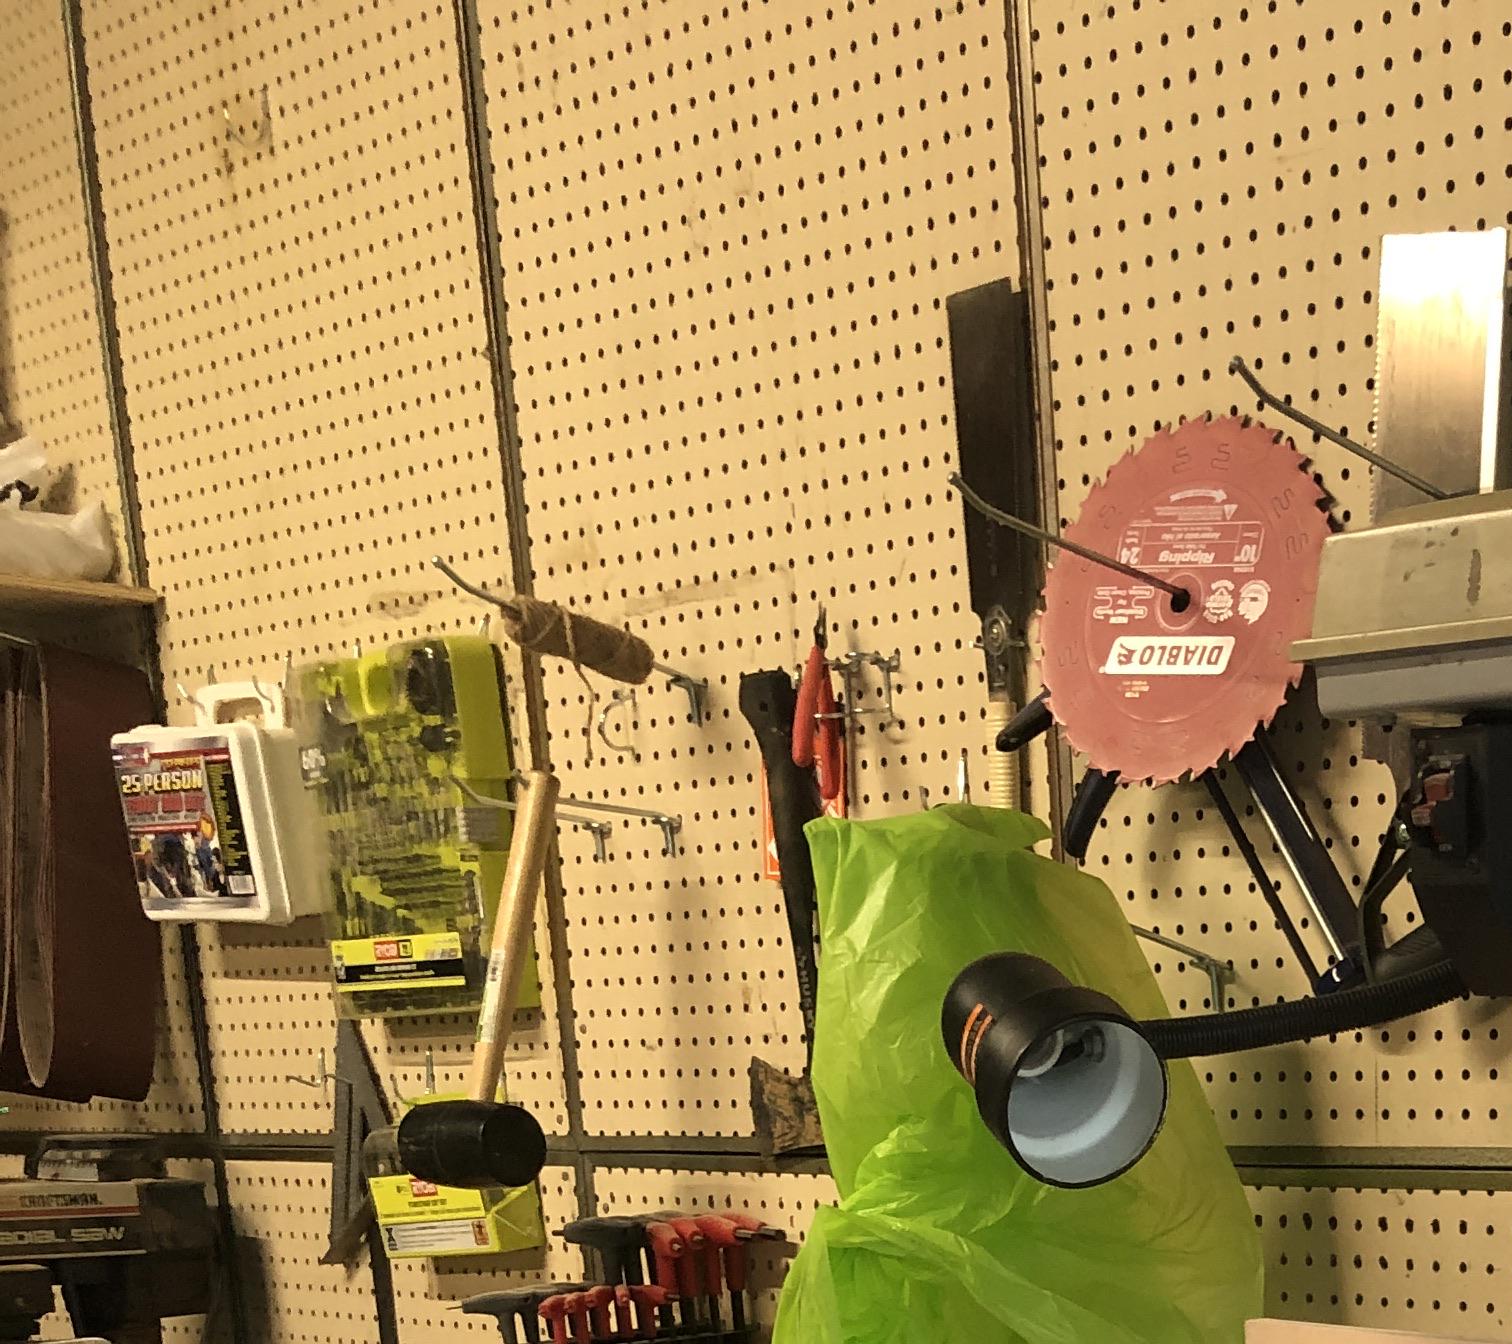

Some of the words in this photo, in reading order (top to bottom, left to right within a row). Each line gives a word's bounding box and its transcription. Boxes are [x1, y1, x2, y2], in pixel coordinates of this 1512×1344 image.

[1121, 547, 1140, 564] 24
[1158, 551, 1215, 565] Ripping
[1139, 644, 1225, 666] DIABLO
[121, 774, 141, 794] 25
[144, 769, 204, 792] PERSON
